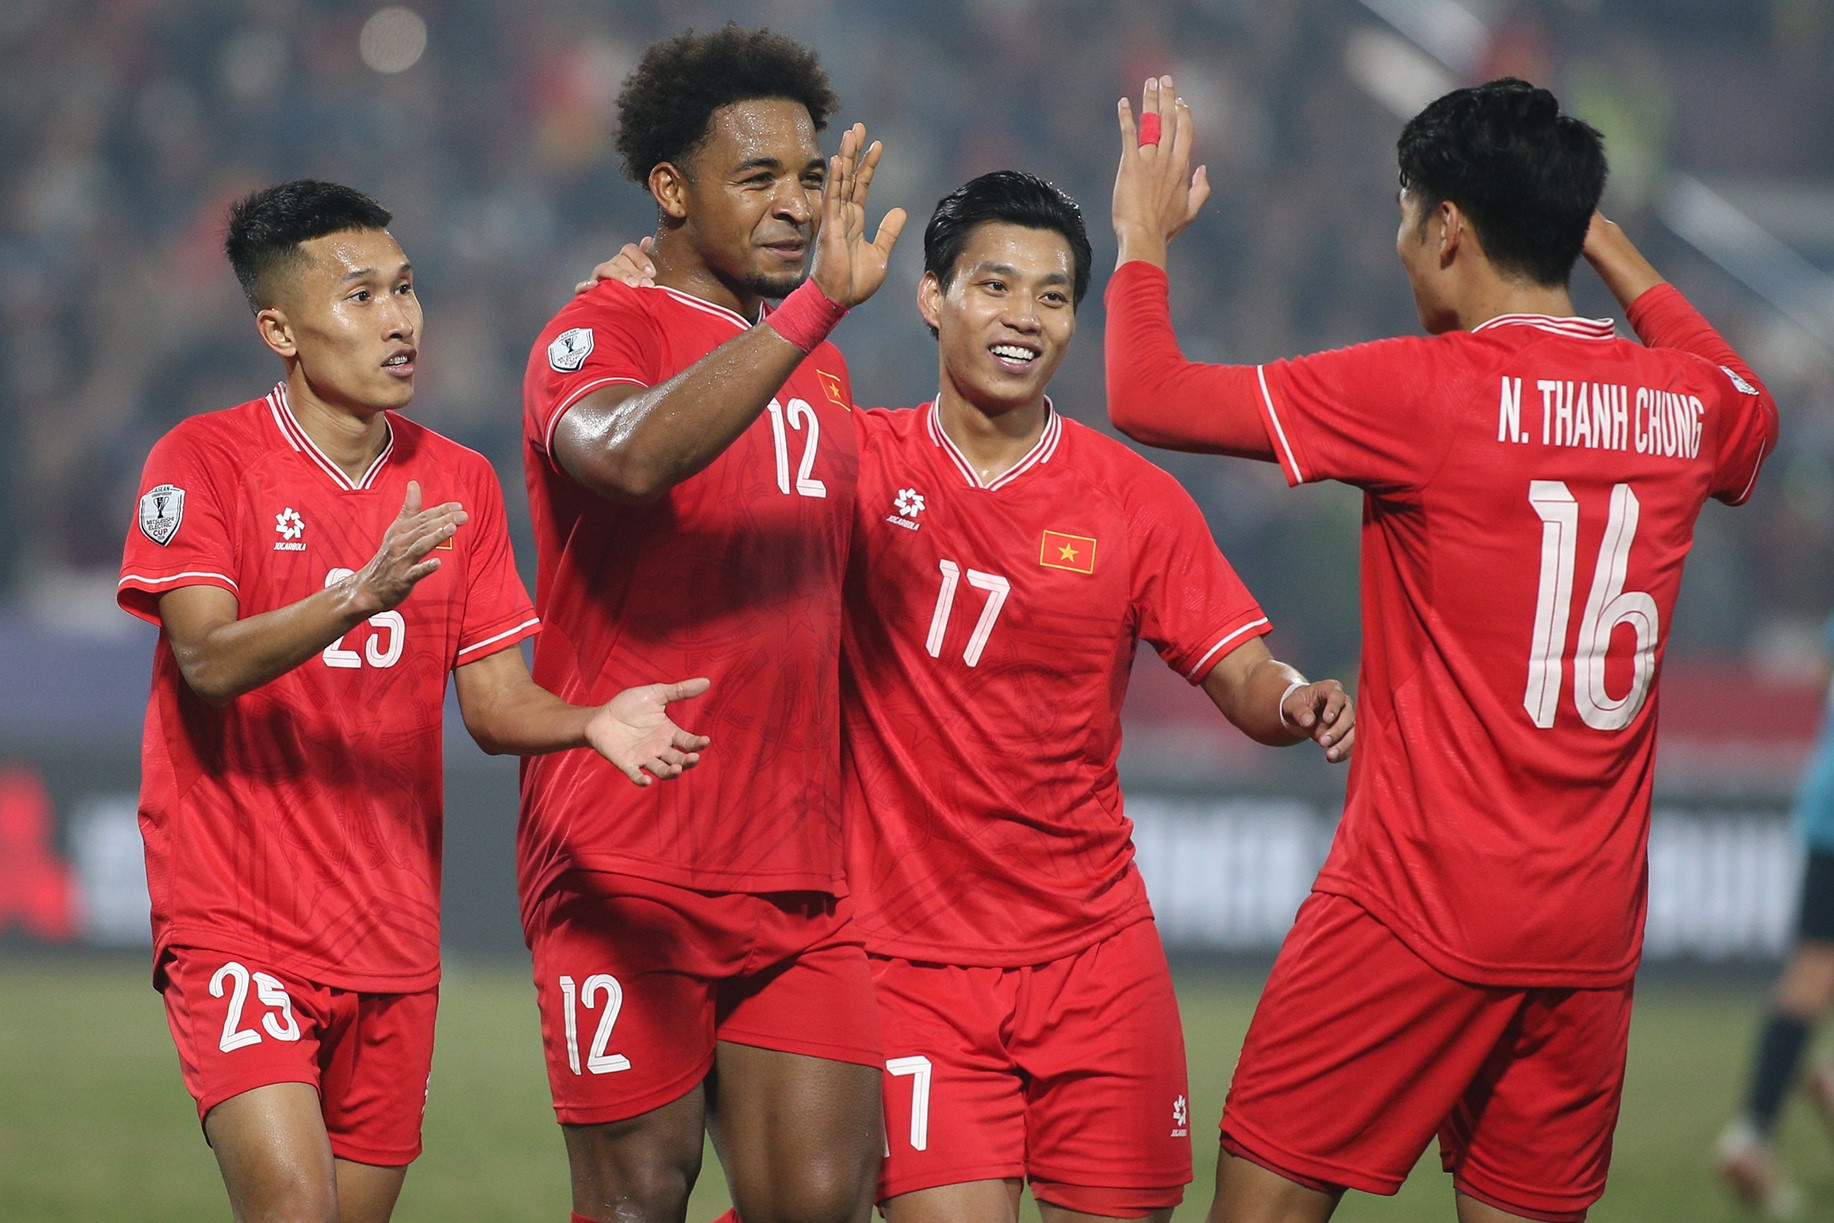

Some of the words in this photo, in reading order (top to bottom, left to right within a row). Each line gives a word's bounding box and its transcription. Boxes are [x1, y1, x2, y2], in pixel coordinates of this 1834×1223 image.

[767, 397, 826, 498] 12
[1498, 376, 1529, 444] N.
[1537, 380, 1628, 451] THANH
[1634, 386, 1704, 459] CHUNG
[153, 528, 168, 536] CUP
[925, 558, 1011, 668] 17
[1523, 480, 1659, 731] 16
[208, 961, 300, 1053] 25
[558, 973, 632, 1075] 12
